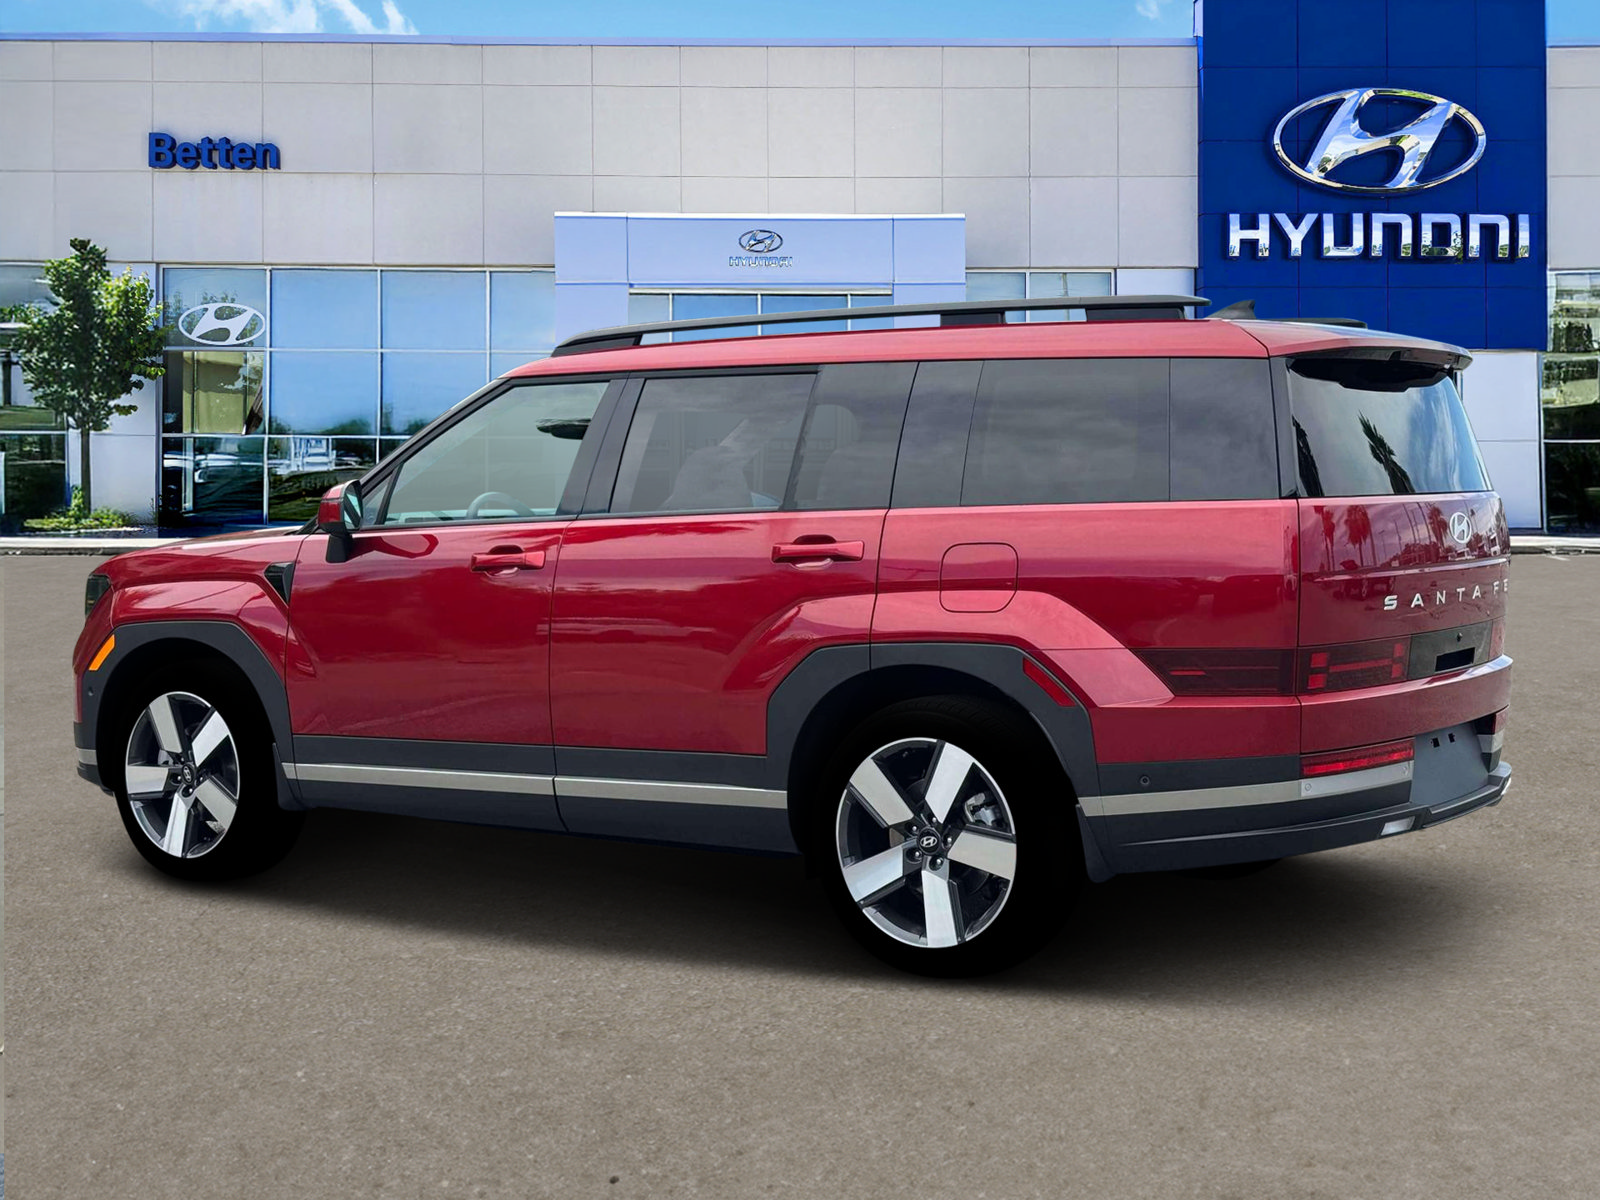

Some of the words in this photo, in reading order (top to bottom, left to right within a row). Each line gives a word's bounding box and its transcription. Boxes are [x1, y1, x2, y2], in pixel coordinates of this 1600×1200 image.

[148, 132, 281, 170] Betten
[1228, 212, 1530, 258] HYUNDAI
[728, 256, 793, 267] HYUNDAI
[1383, 585, 1482, 610] SANTA
[1493, 578, 1508, 598] FE
